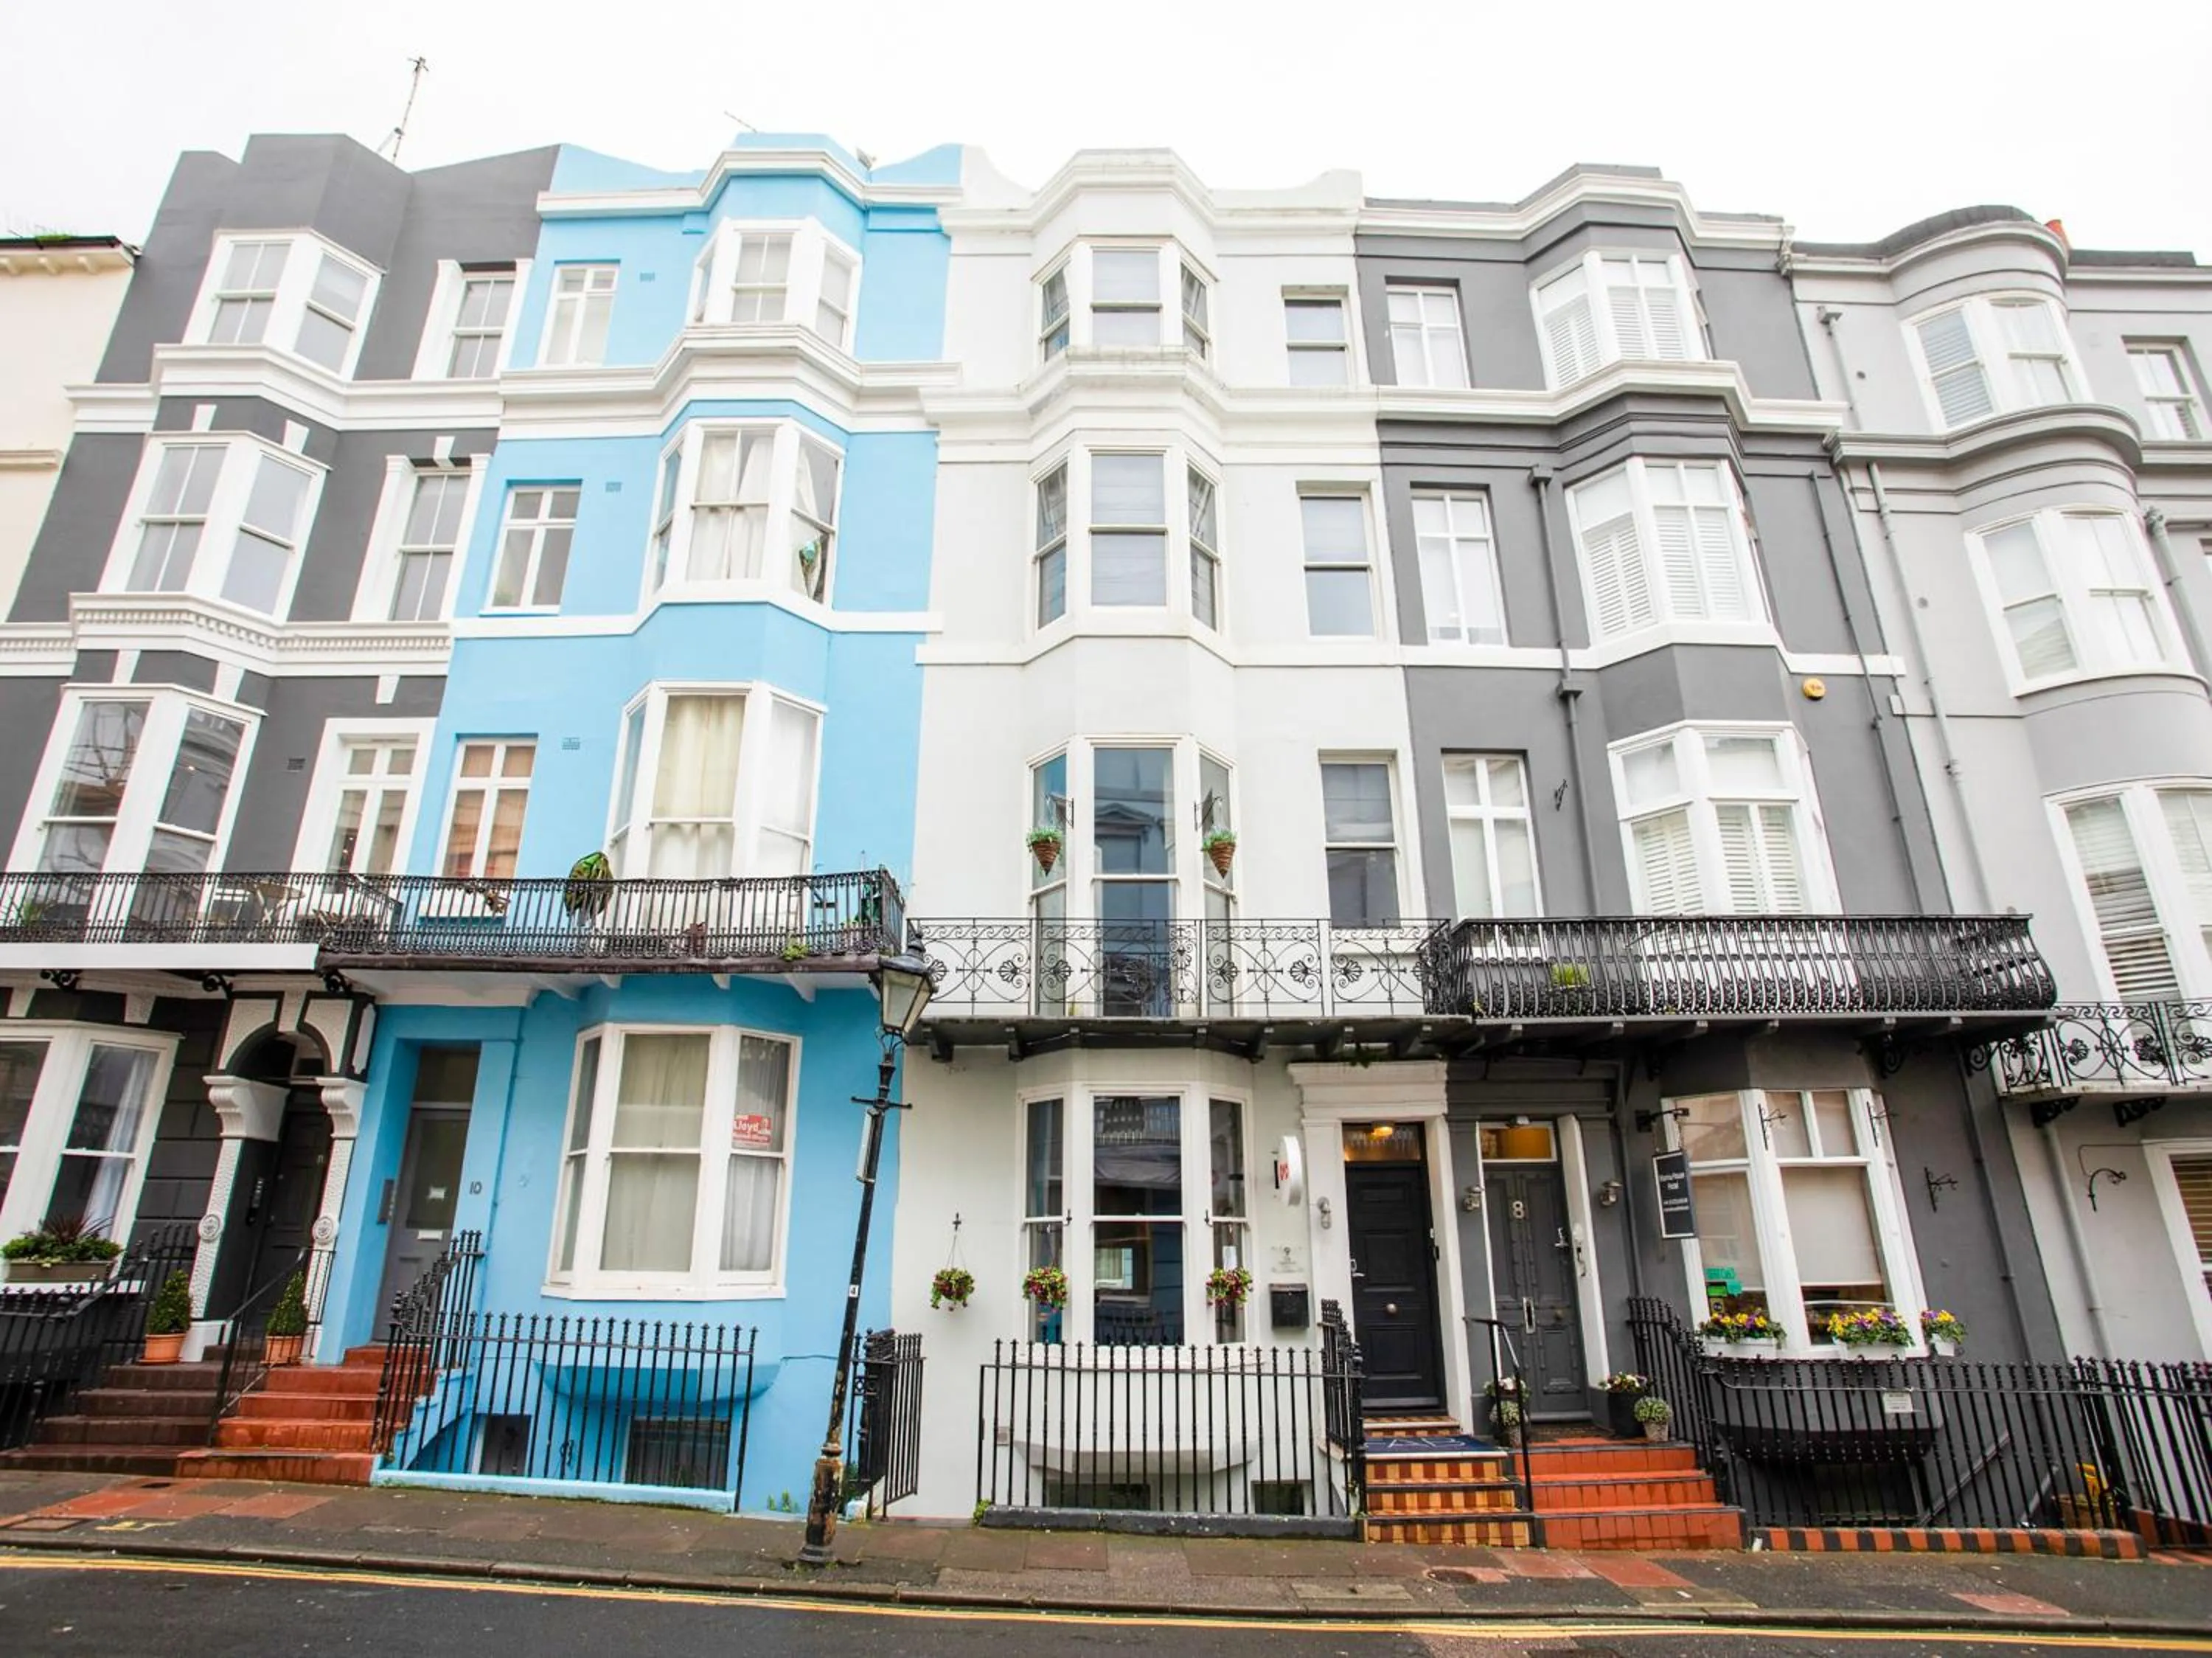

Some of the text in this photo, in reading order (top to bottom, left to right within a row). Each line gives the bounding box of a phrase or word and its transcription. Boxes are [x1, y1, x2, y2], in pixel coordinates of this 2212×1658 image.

[733, 1120, 759, 1137] Lloyd
[469, 1180, 482, 1194] 10
[1512, 1200, 1525, 1218] 8
